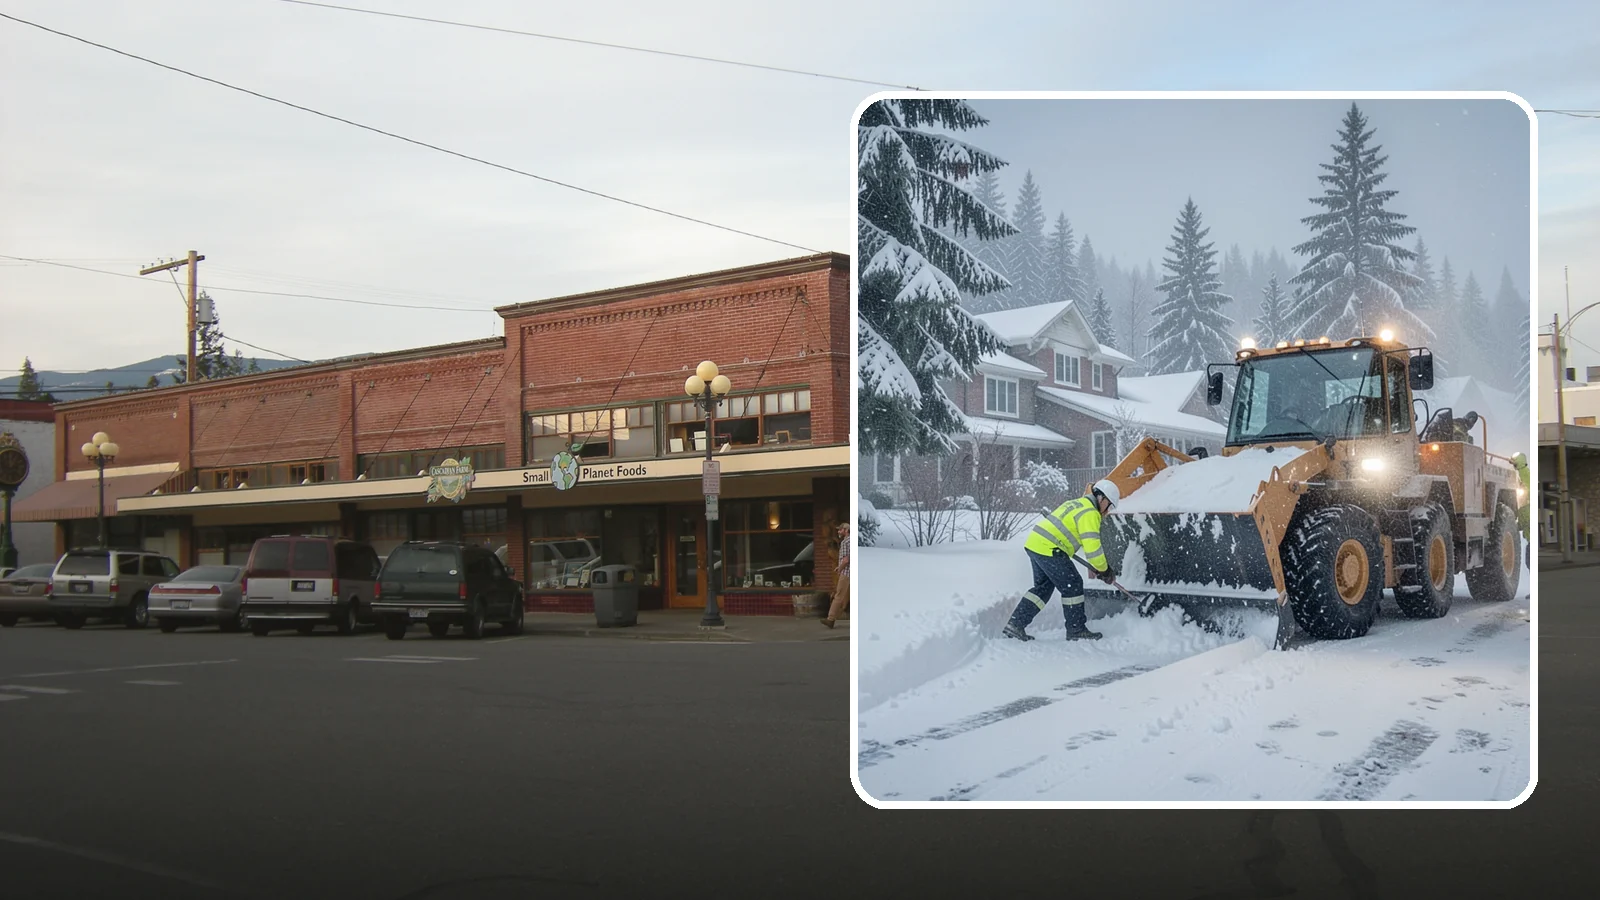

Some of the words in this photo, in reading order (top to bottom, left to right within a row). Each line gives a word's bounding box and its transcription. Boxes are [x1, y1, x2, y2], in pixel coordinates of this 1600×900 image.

[523, 470, 549, 483] Small
[583, 468, 614, 480] Planet
[617, 464, 647, 477] Foods
